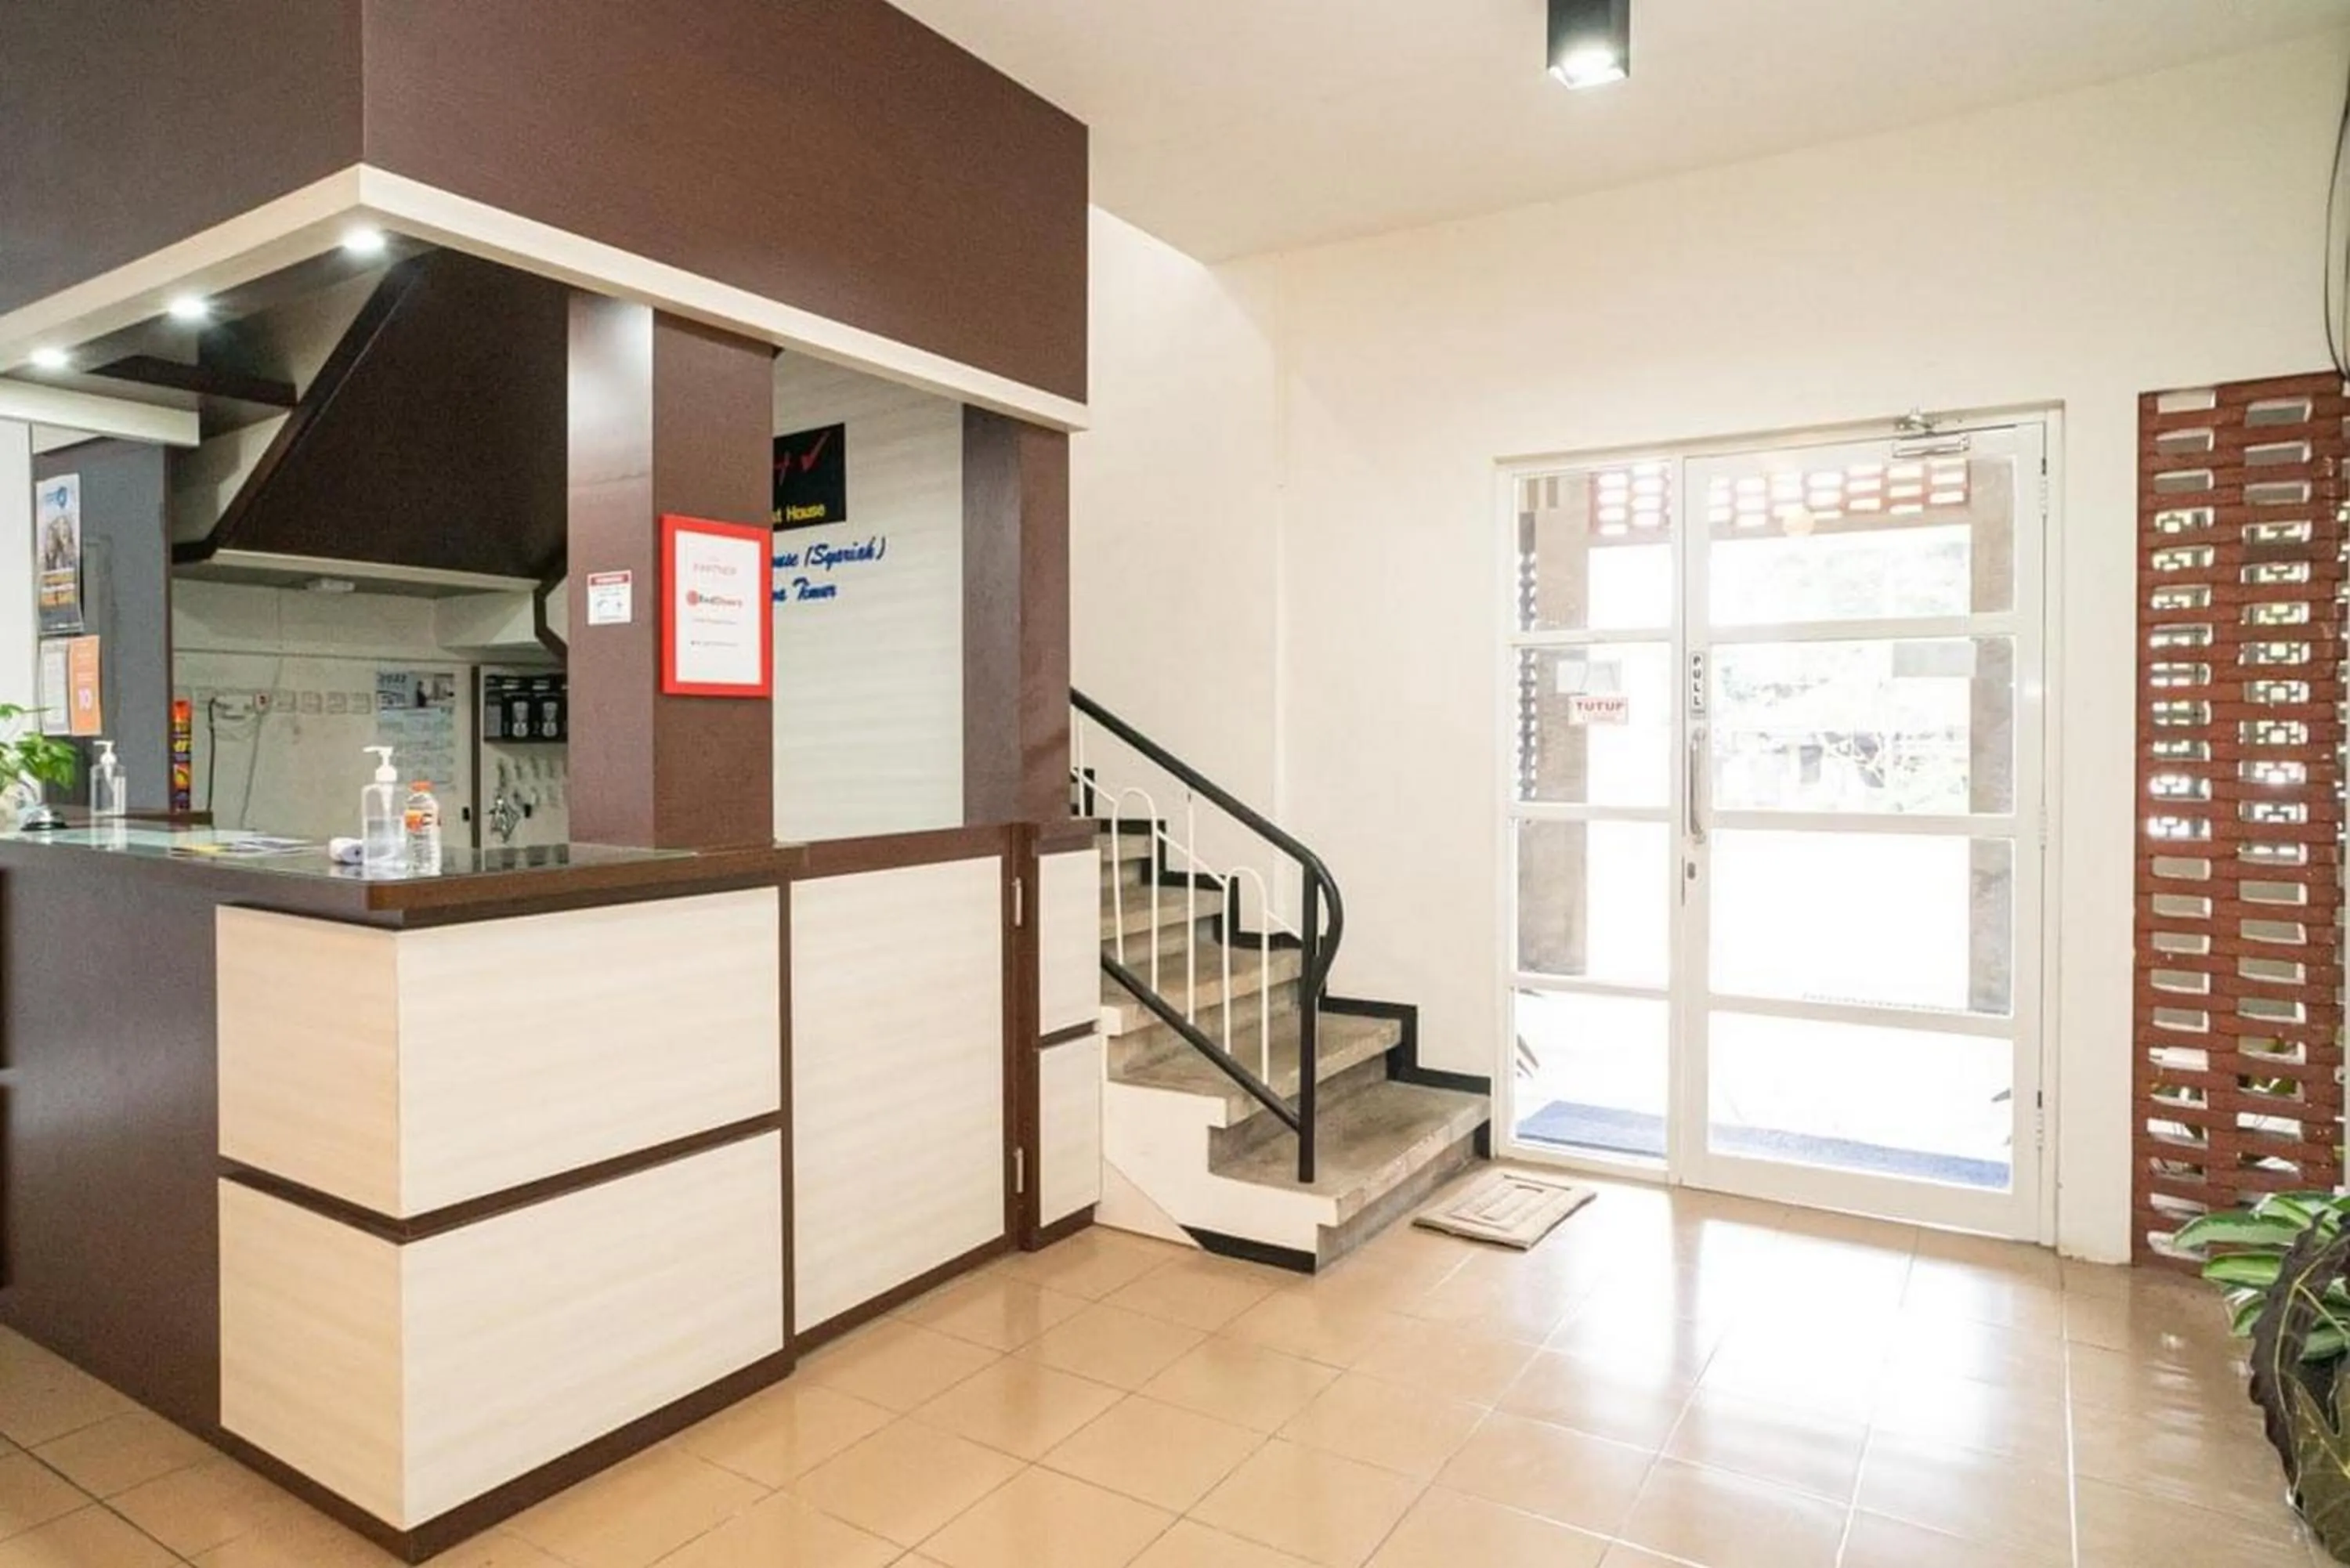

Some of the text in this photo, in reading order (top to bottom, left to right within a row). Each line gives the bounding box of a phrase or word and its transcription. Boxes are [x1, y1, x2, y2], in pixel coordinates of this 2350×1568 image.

[786, 504, 826, 522] House
[1693, 656, 1702, 706] PULL
[1576, 701, 1625, 712] TUTUP
